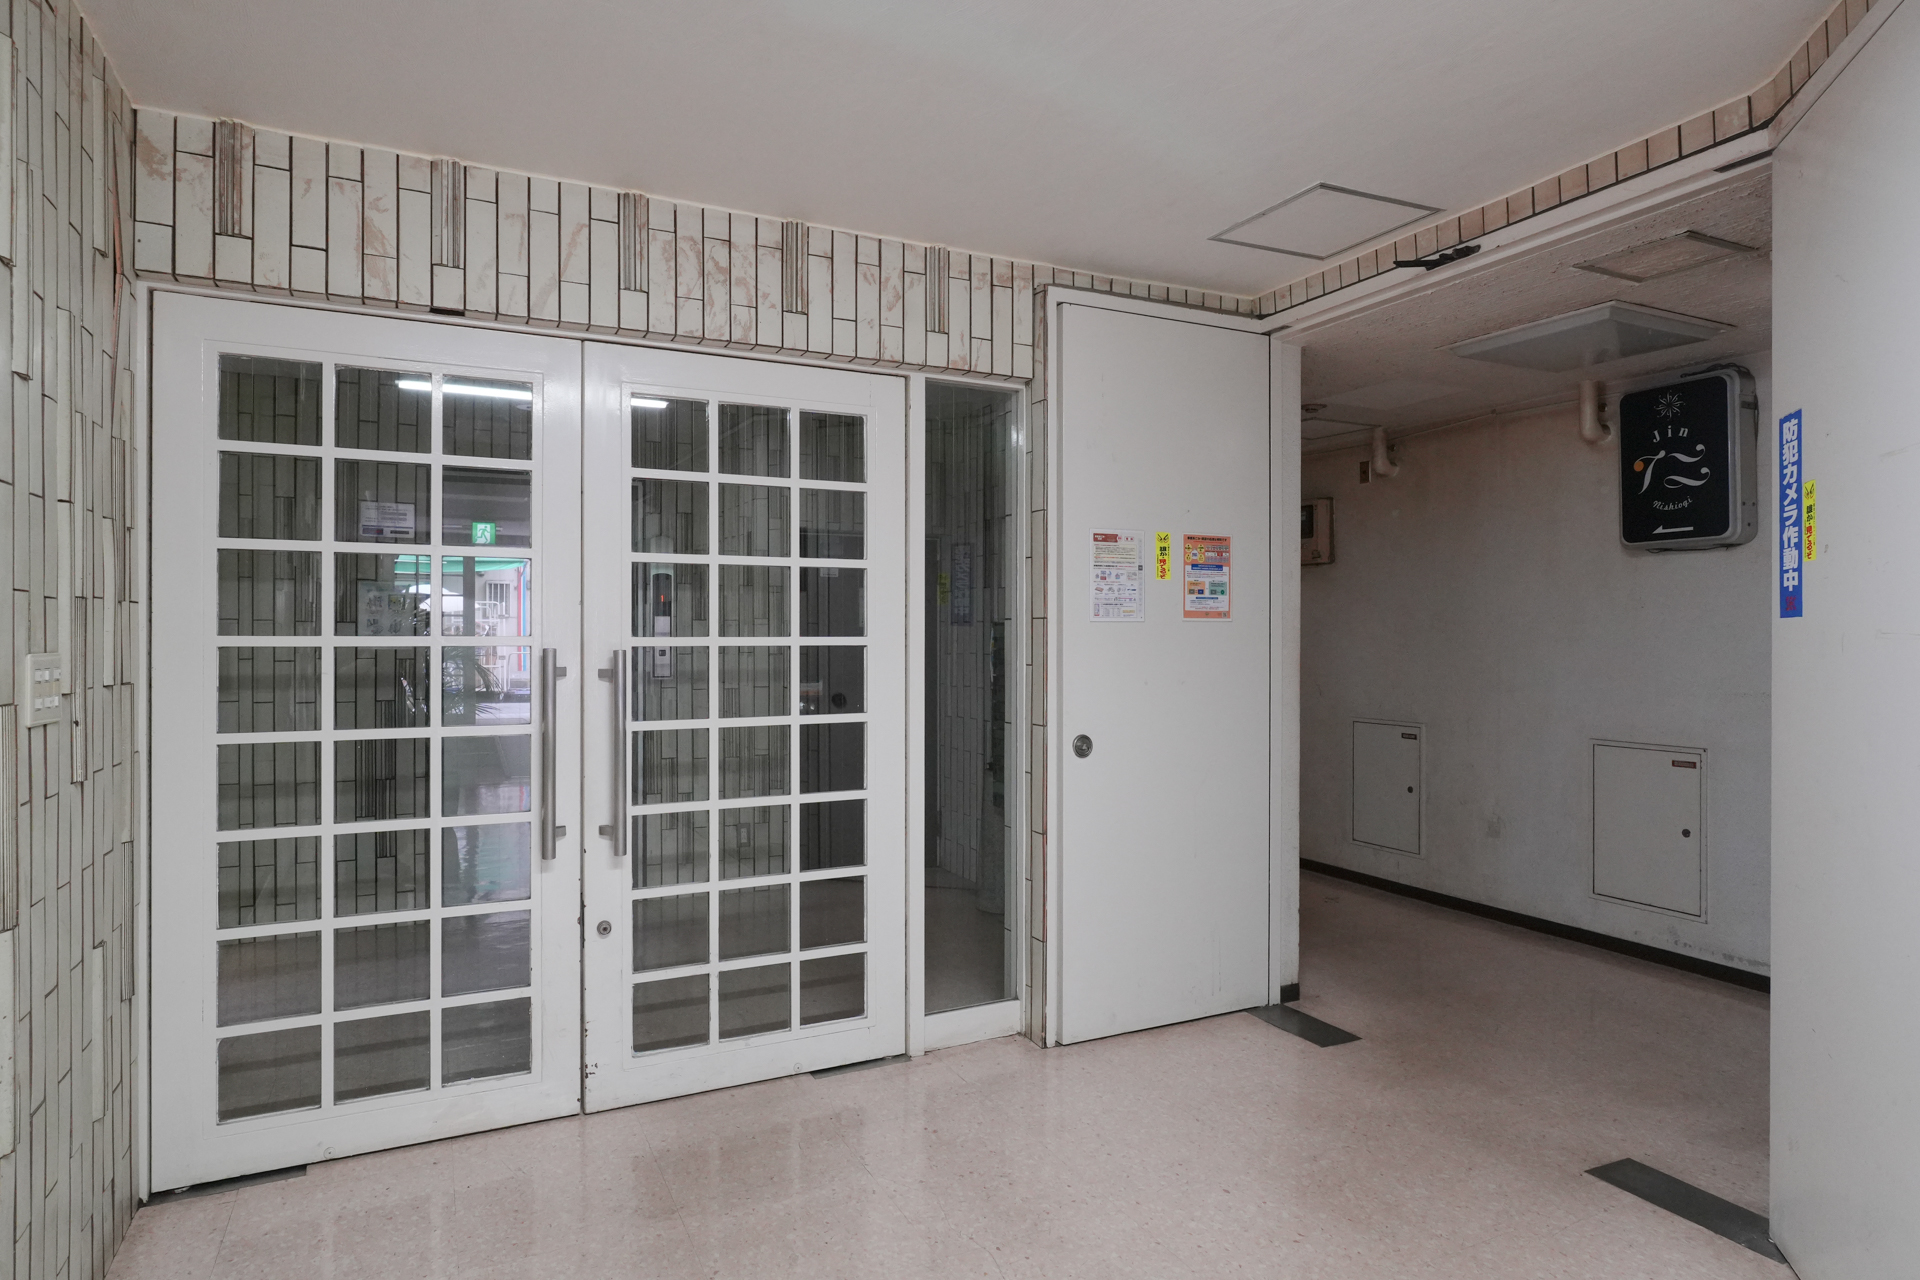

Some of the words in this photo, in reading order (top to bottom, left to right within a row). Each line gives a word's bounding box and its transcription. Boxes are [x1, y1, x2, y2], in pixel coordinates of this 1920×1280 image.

[1652, 425, 1689, 443] Jin
[1652, 496, 1693, 511] Nishiogi
[1782, 418, 1799, 591] 防犯カメラ作動中
